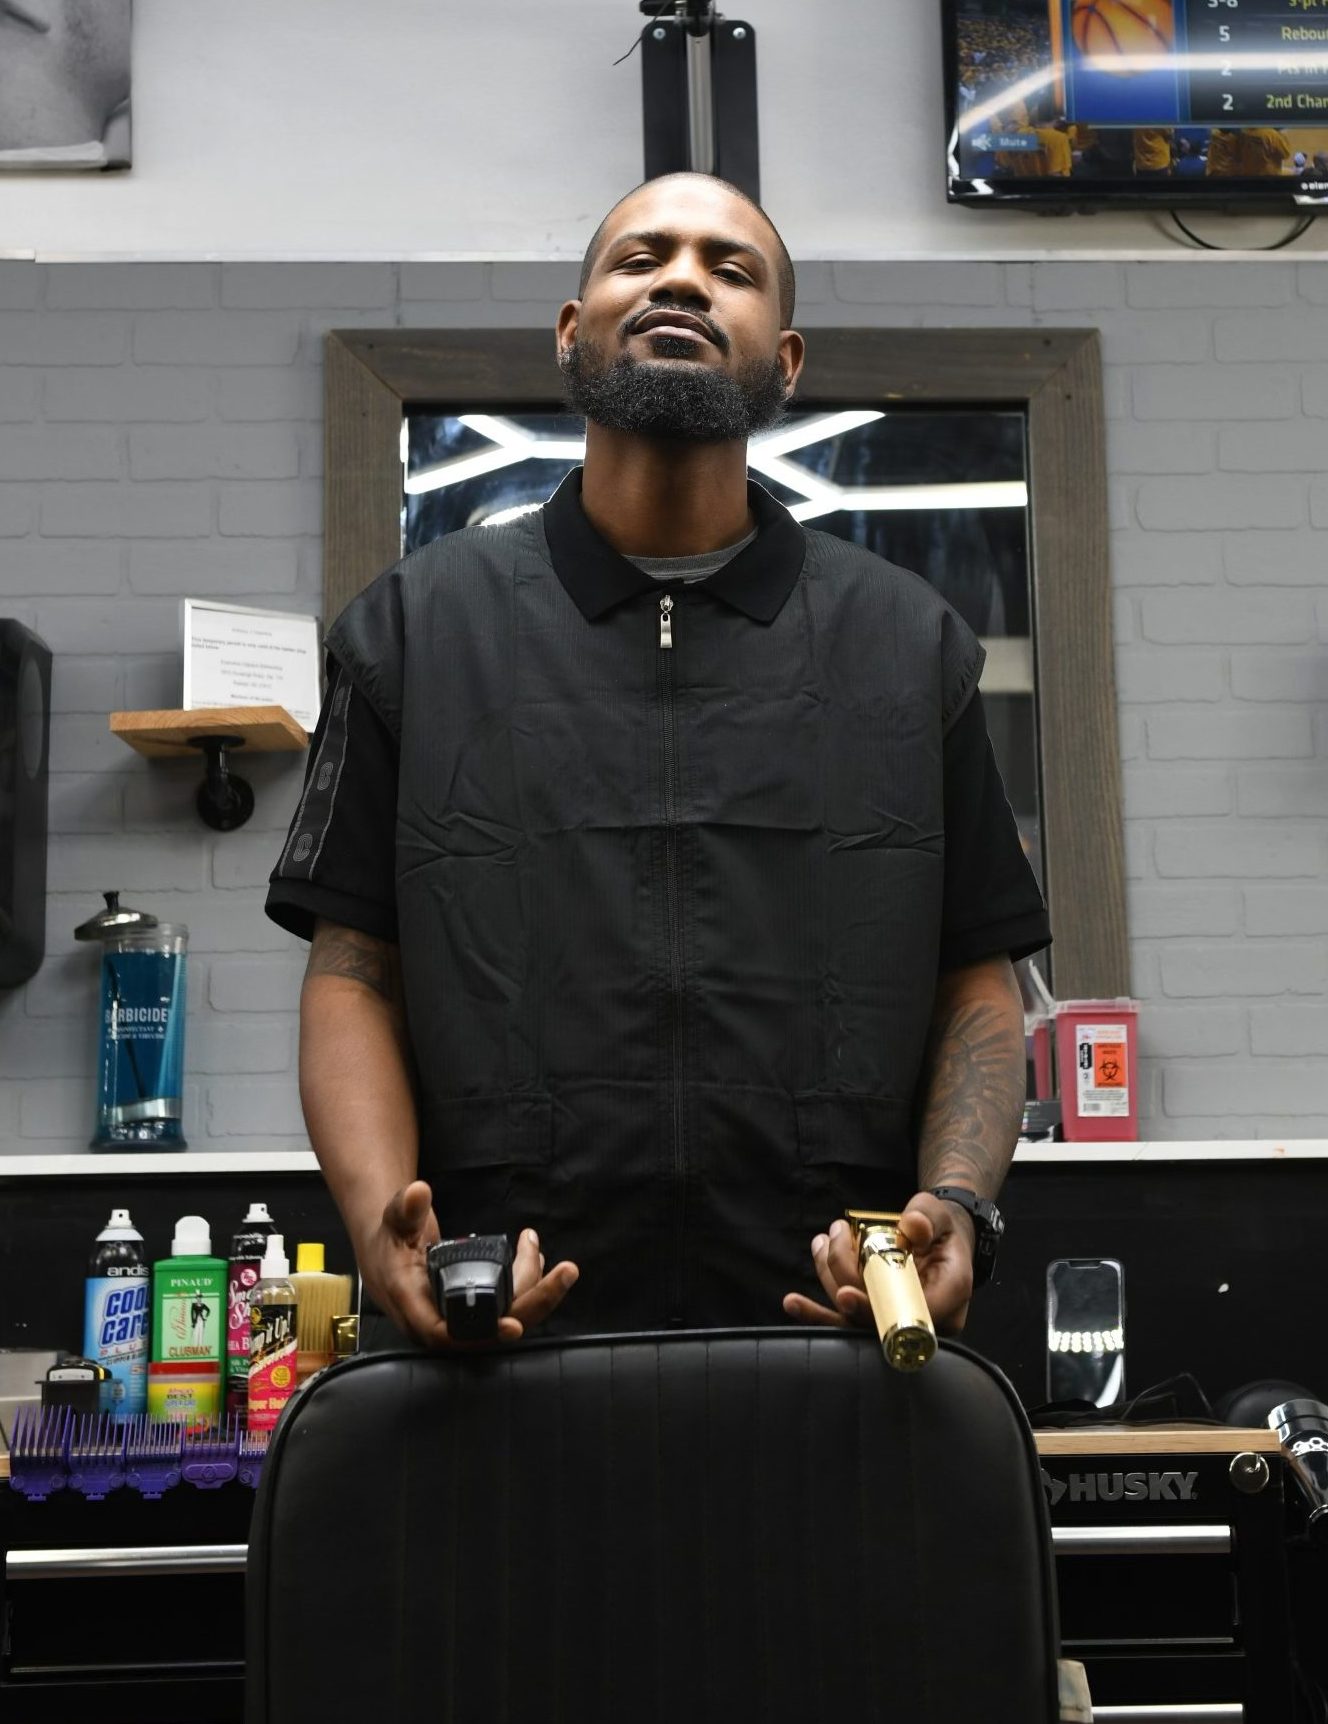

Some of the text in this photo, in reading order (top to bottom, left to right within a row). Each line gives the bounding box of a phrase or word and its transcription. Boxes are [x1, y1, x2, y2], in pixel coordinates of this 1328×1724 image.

[1219, 25, 1231, 42] 5
[1222, 93, 1234, 111] 2
[1266, 94, 1293, 109] 2nd
[107, 1262, 149, 1277] andis
[171, 1278, 212, 1288] PINAUD
[169, 1345, 210, 1357] CLUBMAN
[1069, 1472, 1198, 1501] HUSKY
